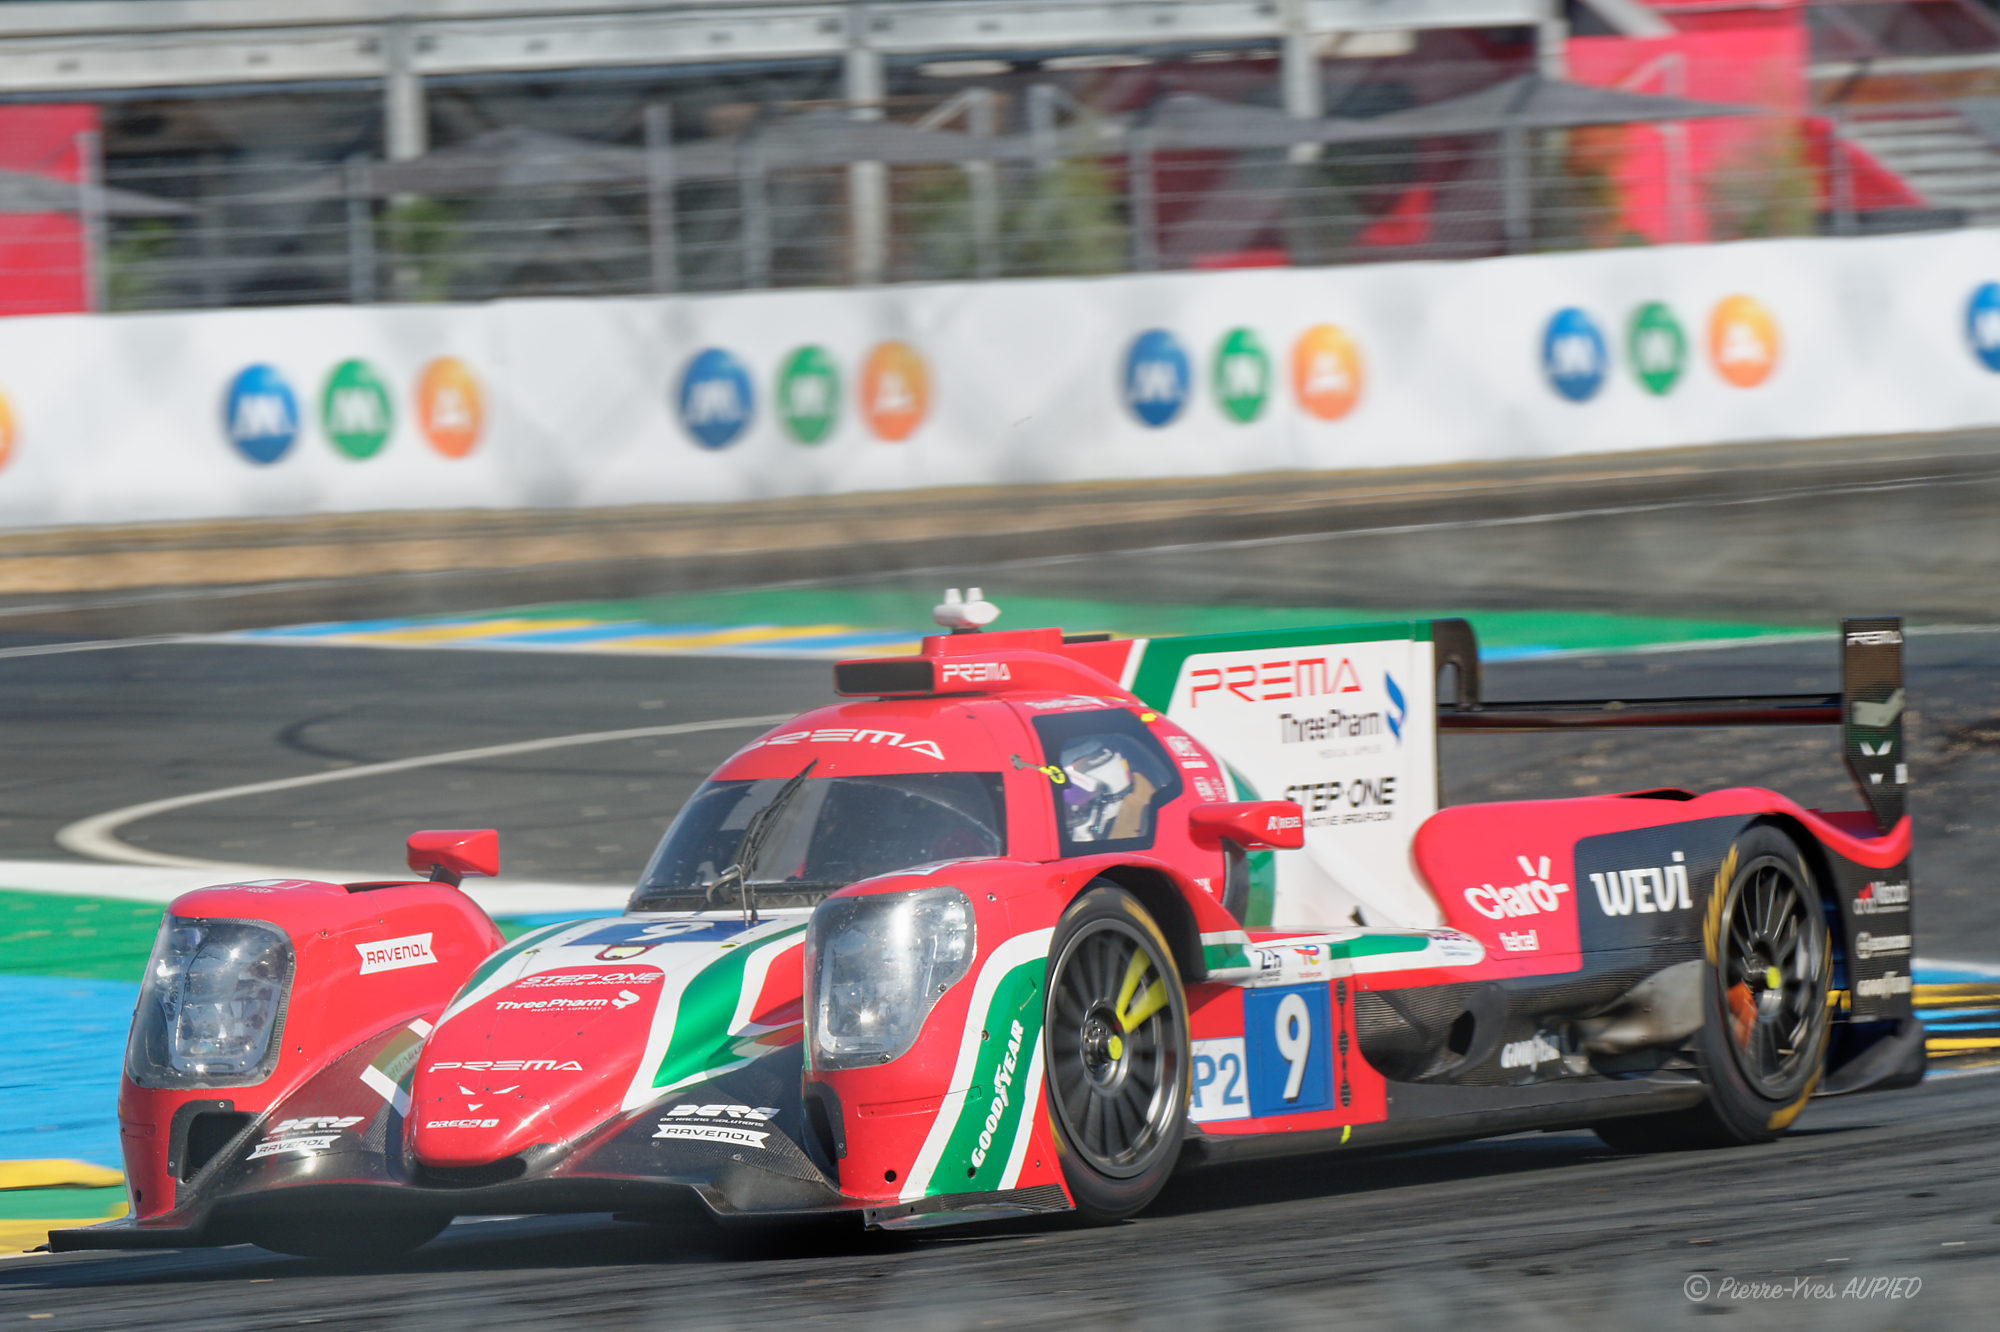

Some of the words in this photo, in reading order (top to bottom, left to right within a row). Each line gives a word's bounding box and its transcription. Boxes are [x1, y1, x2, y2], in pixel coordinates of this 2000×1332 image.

[942, 662, 1012, 683] PREMA
[1190, 657, 1363, 708] PREMA
[1463, 879, 1561, 920] Claro
[366, 943, 429, 966] RAVENOL
[1274, 992, 1312, 1101] 9
[428, 1060, 583, 1073] PREMA
[971, 1019, 1024, 1168] GOODYEAR
[712, 1118, 765, 1128] SOLUTIONS
[257, 1138, 326, 1154] RAVENOL
[666, 1127, 756, 1143] RAVENOL
